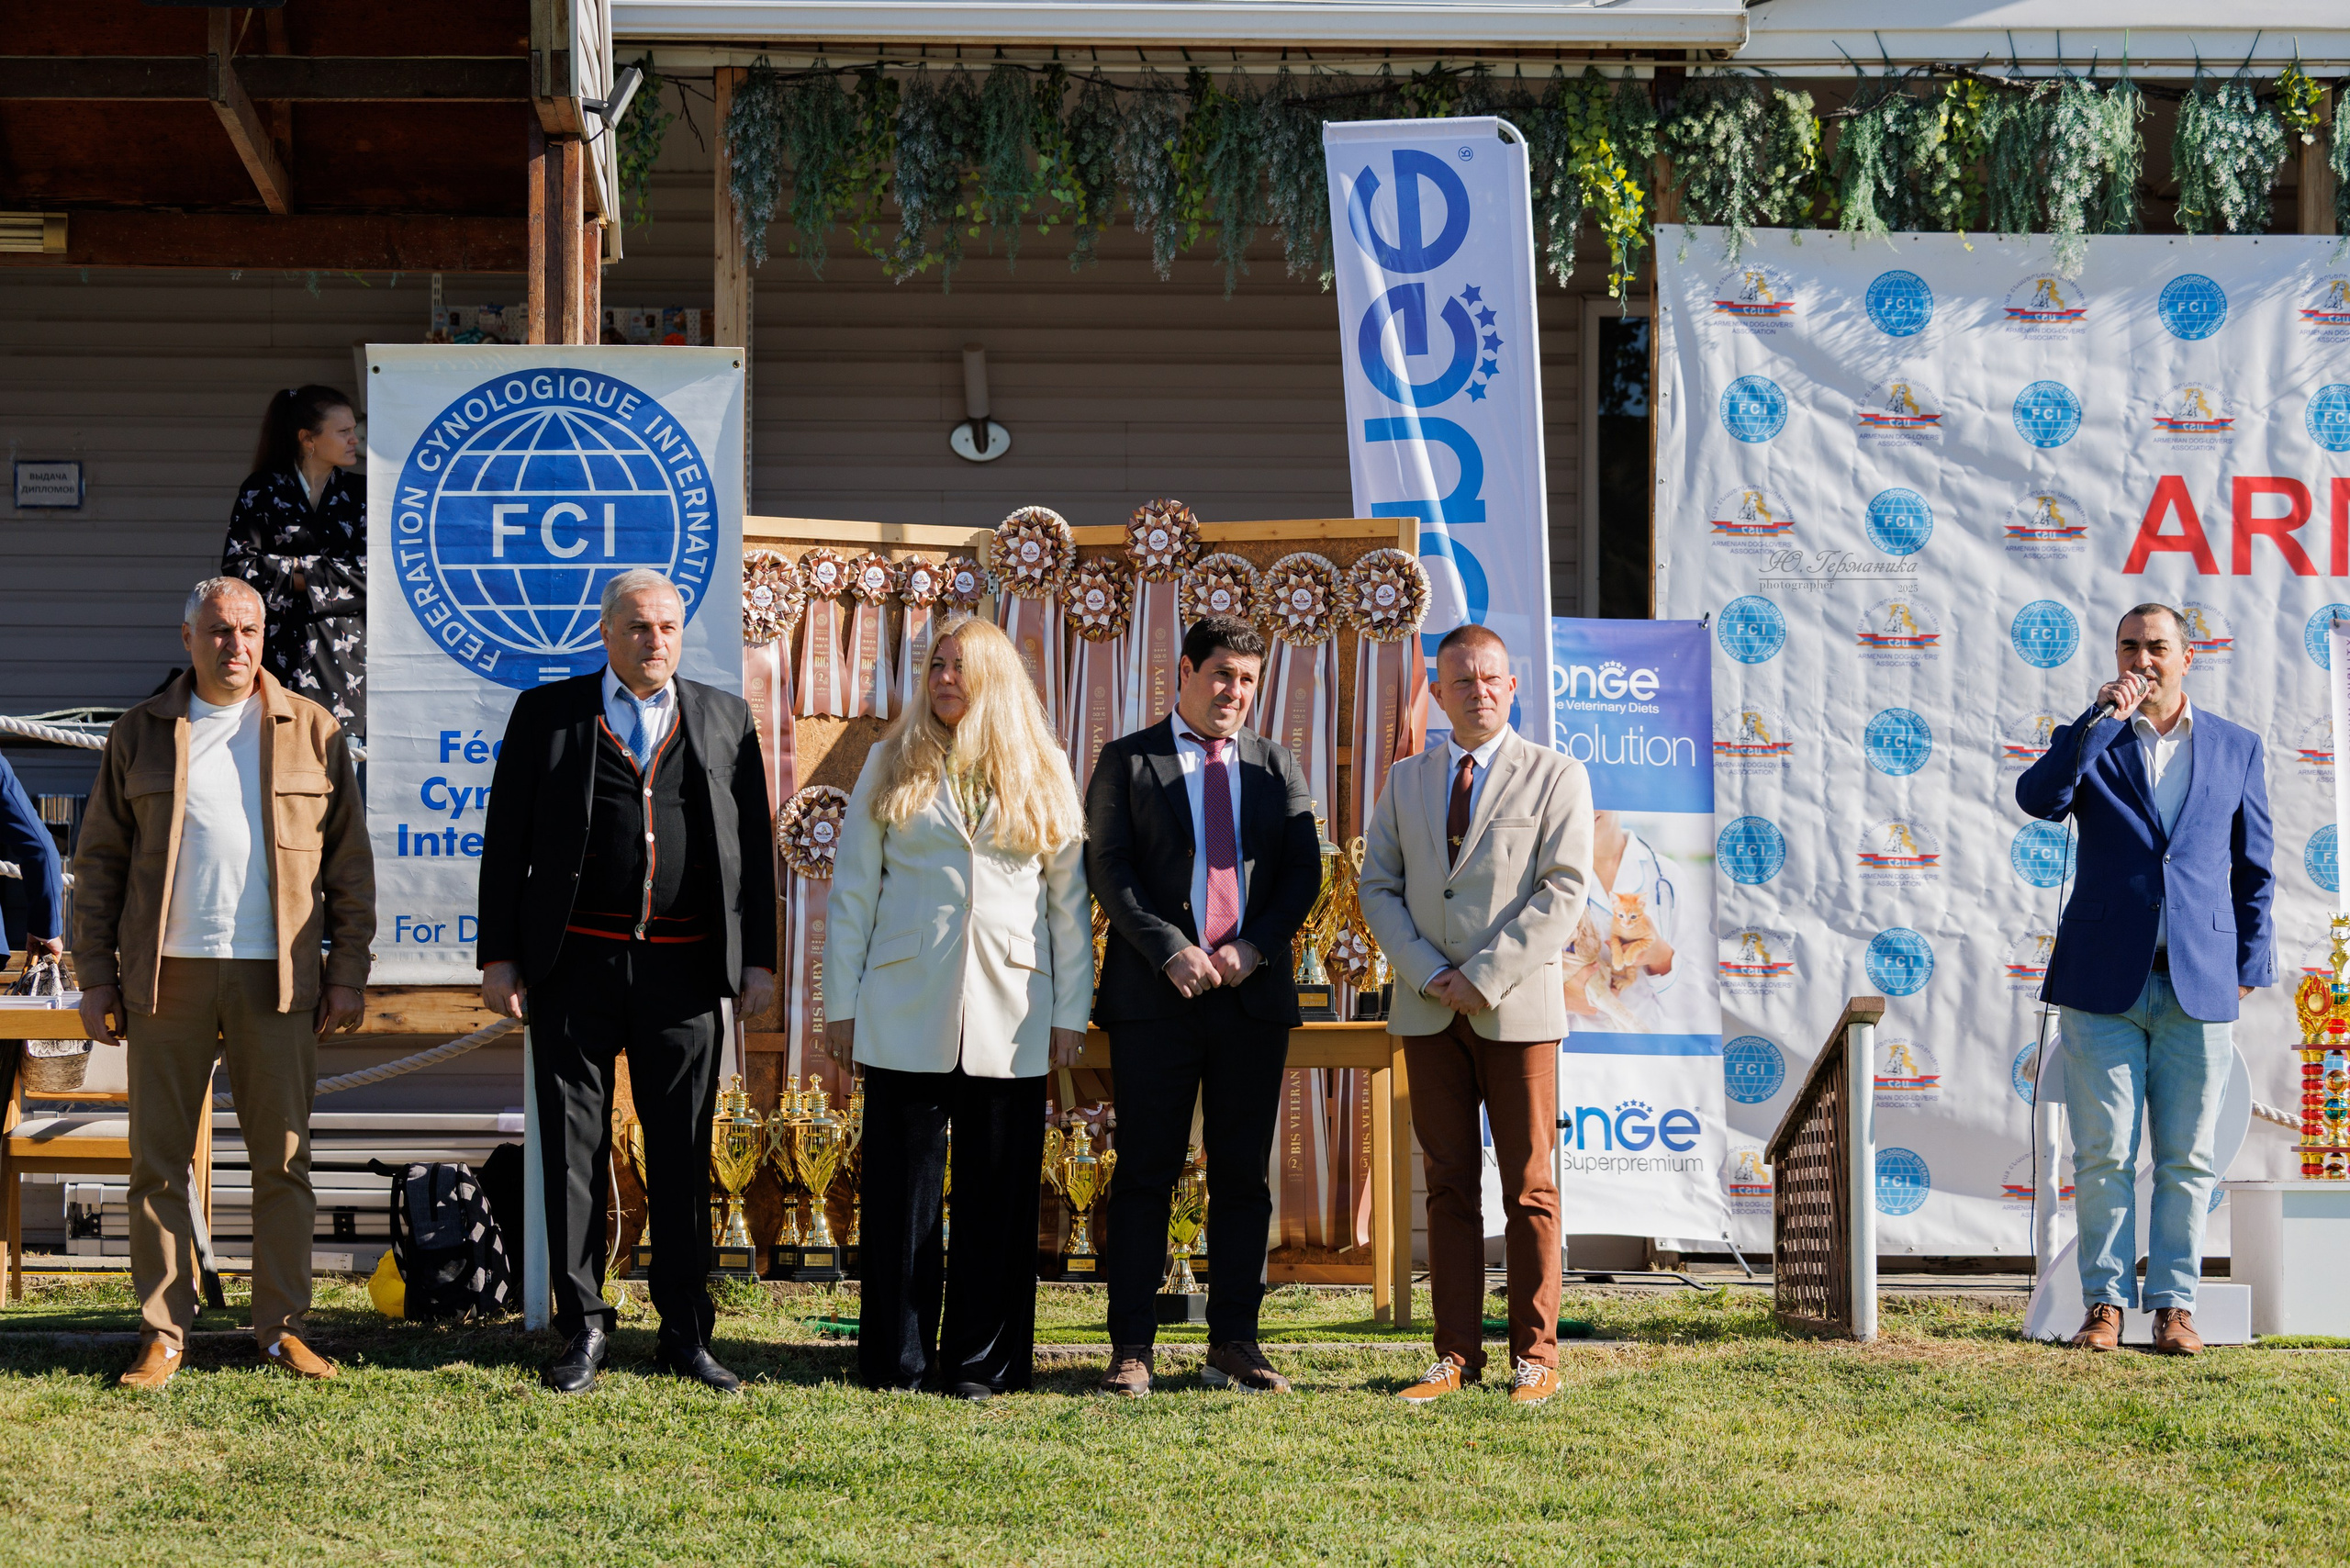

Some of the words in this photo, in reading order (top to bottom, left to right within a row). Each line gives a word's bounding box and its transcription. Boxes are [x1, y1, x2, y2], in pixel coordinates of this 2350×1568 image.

[1871, 271, 1918, 291] CYNOLOGIQUE
[2164, 274, 2210, 295] CYNOLOGIQUE
[1885, 297, 1912, 308] FCI
[2178, 301, 2206, 312] FCI
[1867, 295, 1888, 333] FEDERATION
[2160, 298, 2181, 337] FEDERATION
[1725, 376, 1772, 397] CYNOLOGIQUE
[2019, 382, 2065, 401] CYNOLOGIQUE
[1740, 403, 1767, 414] FCI
[2033, 409, 2061, 420] FCI
[2325, 412, 2344, 423] FC
[417, 375, 642, 472] CYNOLOGIQUE
[1721, 400, 1742, 439] FEDERATION
[2015, 405, 2036, 443] FEDERATION
[1870, 489, 1917, 510] CYNOLOGIQUE
[643, 415, 711, 607] INTERNATIO
[493, 502, 615, 559] FCI
[1885, 516, 1912, 527] FCI
[1866, 513, 1887, 552] FEDERATION
[398, 486, 502, 672] FEDERATION
[1723, 597, 1770, 617] CYNOLOGIQUE
[2017, 602, 2064, 622] CYNOLOGIQUE
[1737, 623, 1764, 634] FCI
[2031, 629, 2058, 640] FCI
[1719, 621, 1740, 659] FEDERATION
[2013, 625, 2034, 664] FEDERATION
[814, 655, 829, 668] BIG
[861, 658, 876, 670] BIG
[818, 672, 823, 682] 2
[865, 675, 869, 685] 2
[1155, 666, 1165, 716] PUPPY
[1565, 700, 1627, 714] Veterinary
[1628, 701, 1660, 714] Diets
[1869, 710, 1916, 729] CYNOLOGIQUE
[1865, 733, 1886, 771] FEDERATION
[1723, 818, 1770, 838] CYNOLOGIQUE
[397, 823, 485, 857] Inte
[1737, 845, 1764, 856] FCI
[2031, 848, 2058, 859] FCI
[1719, 842, 1740, 880] FEDERATION
[397, 915, 445, 944] For
[460, 916, 478, 944] D
[1871, 929, 1918, 949] CYNOLOGIQUE
[1886, 956, 1913, 967] FCI
[812, 959, 822, 1002] BABY
[1867, 953, 1888, 991] FEDERATION
[812, 1006, 823, 1033] BIS
[1736, 1063, 1763, 1074] FCI
[1290, 1070, 1301, 1129] VETERAN
[1290, 1133, 1301, 1155] BIS
[1362, 1132, 1371, 1154] BIS
[1882, 1175, 1909, 1186] FCI
